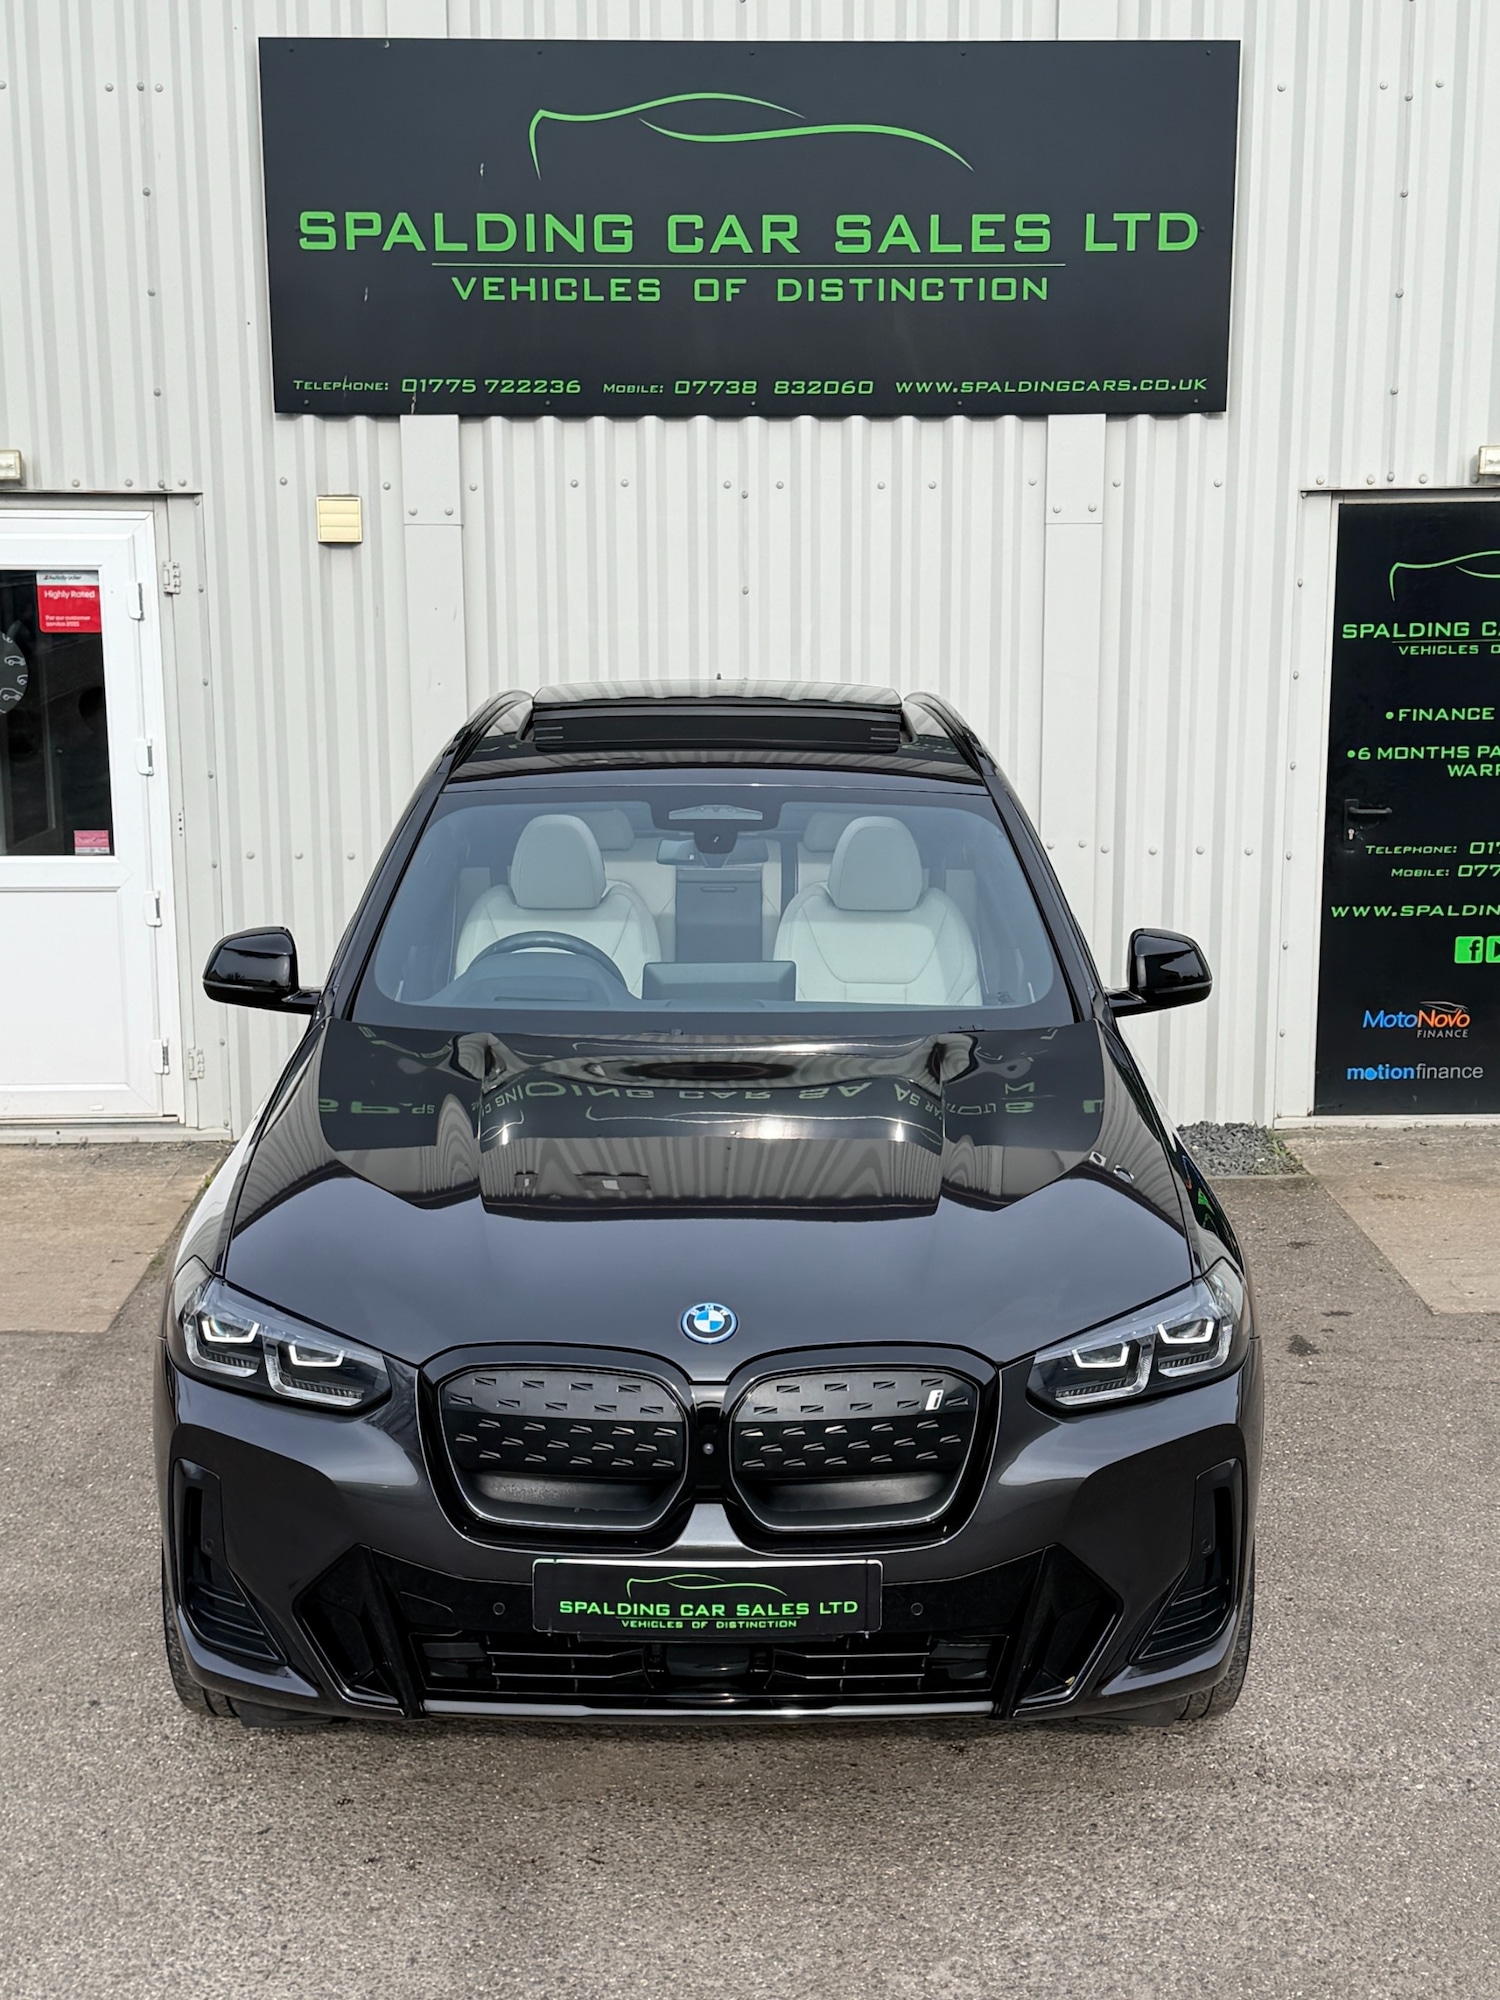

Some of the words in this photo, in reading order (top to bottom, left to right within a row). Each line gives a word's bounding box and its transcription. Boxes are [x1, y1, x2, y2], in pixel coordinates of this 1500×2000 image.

[300, 211, 634, 254] SPALDING
[667, 213, 799, 254] CAR
[834, 213, 1051, 254] SALES
[1084, 212, 1199, 253] LTD
[452, 276, 661, 303] VEHICLES
[693, 277, 747, 303] OF
[777, 277, 1048, 303] DISTINCTION
[401, 378, 477, 394] 01775
[485, 378, 582, 395] 722236
[673, 380, 758, 396] 07738
[773, 380, 875, 396] 832060
[1342, 621, 1470, 639] SPALDING
[1481, 621, 1500, 637] C
[1399, 644, 1479, 656] VEHICLES
[1398, 707, 1496, 722] FINANCE
[1357, 747, 1371, 760] 6
[1377, 745, 1470, 760] MONTHS
[1362, 1006, 1471, 1029] MotoNovo
[1416, 1029, 1469, 1039] FINANCE
[1346, 1063, 1484, 1081] motionfinance
[559, 1600, 671, 1617] SPALDING
[679, 1602, 726, 1617] CAR
[735, 1601, 810, 1617] SALES
[818, 1601, 859, 1615] LTD
[621, 1619, 684, 1630] VEHICLES
[691, 1620, 708, 1630] OF
[715, 1619, 798, 1630] DISTINCTION
